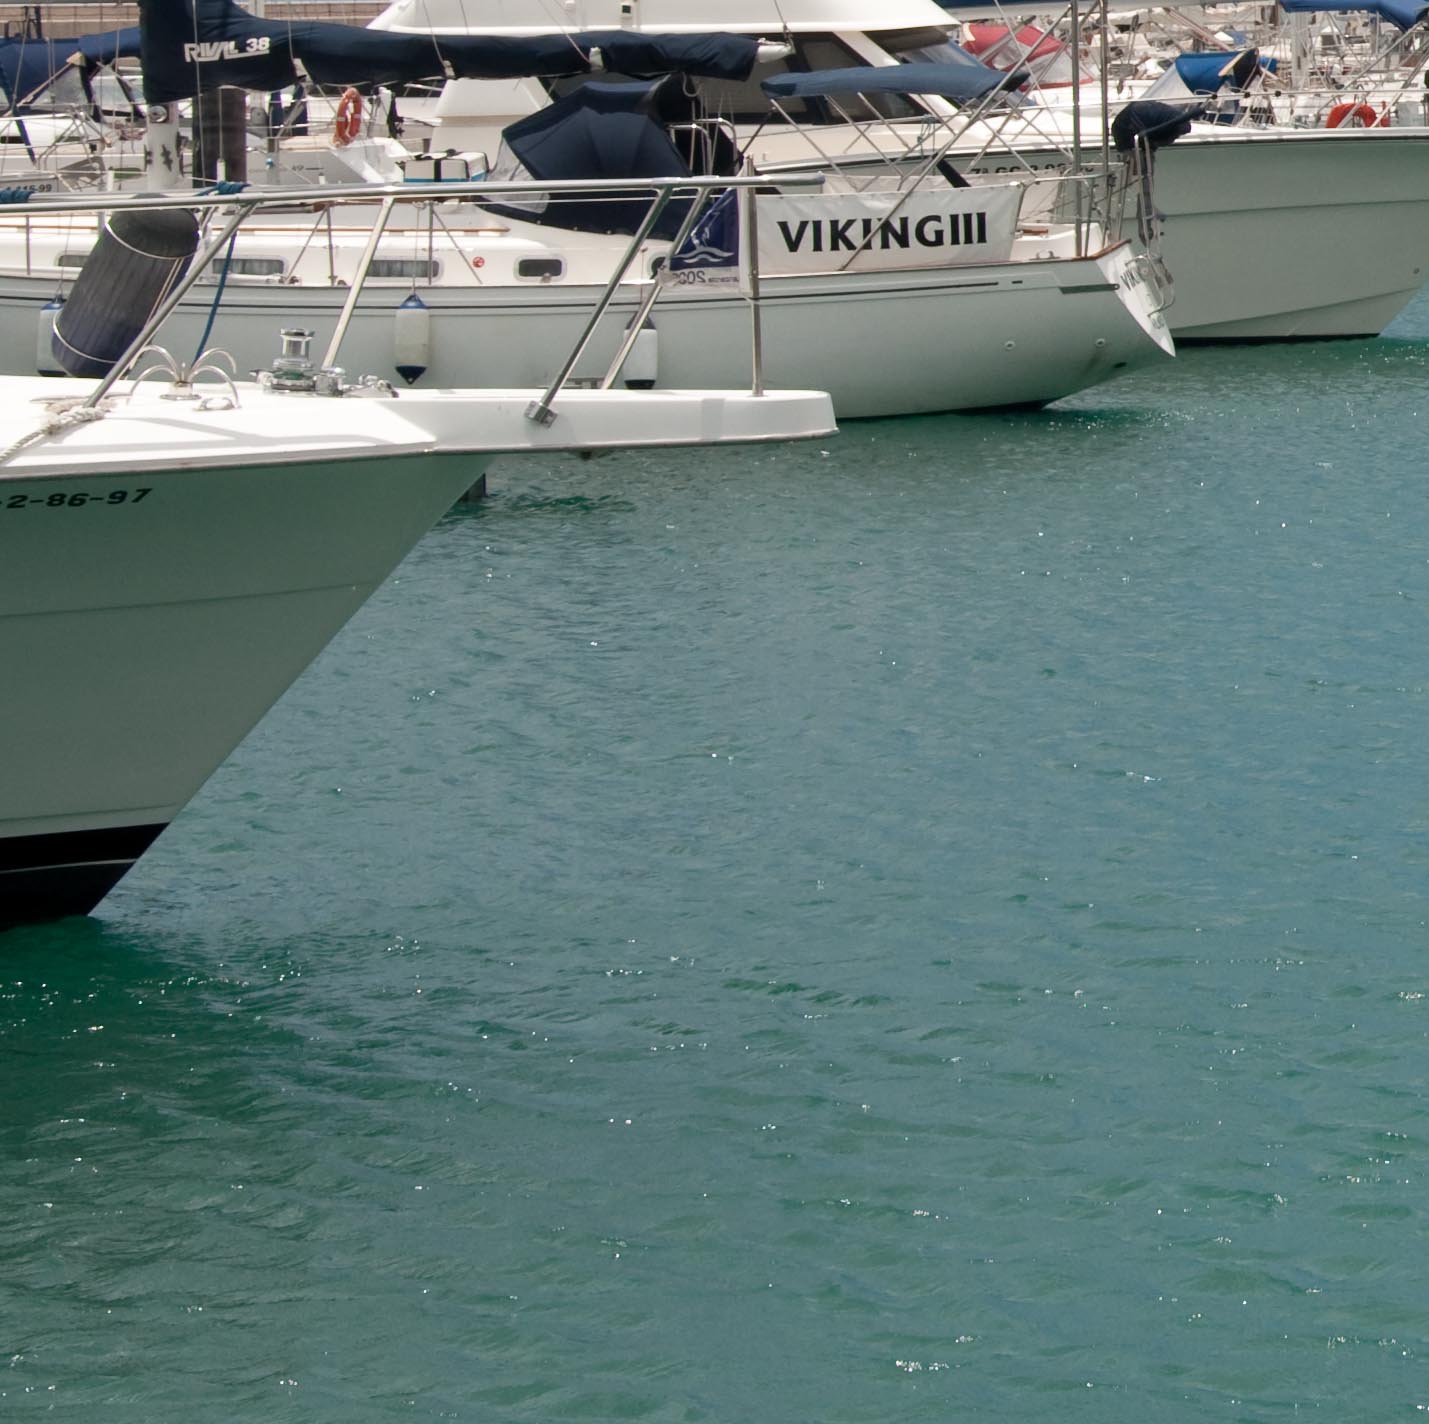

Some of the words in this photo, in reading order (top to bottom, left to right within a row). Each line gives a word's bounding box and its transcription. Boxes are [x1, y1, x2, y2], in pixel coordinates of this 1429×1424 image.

[184, 40, 238, 63] RIVAL
[245, 37, 270, 52] 38
[0, 488, 152, 509] 2-86-97
